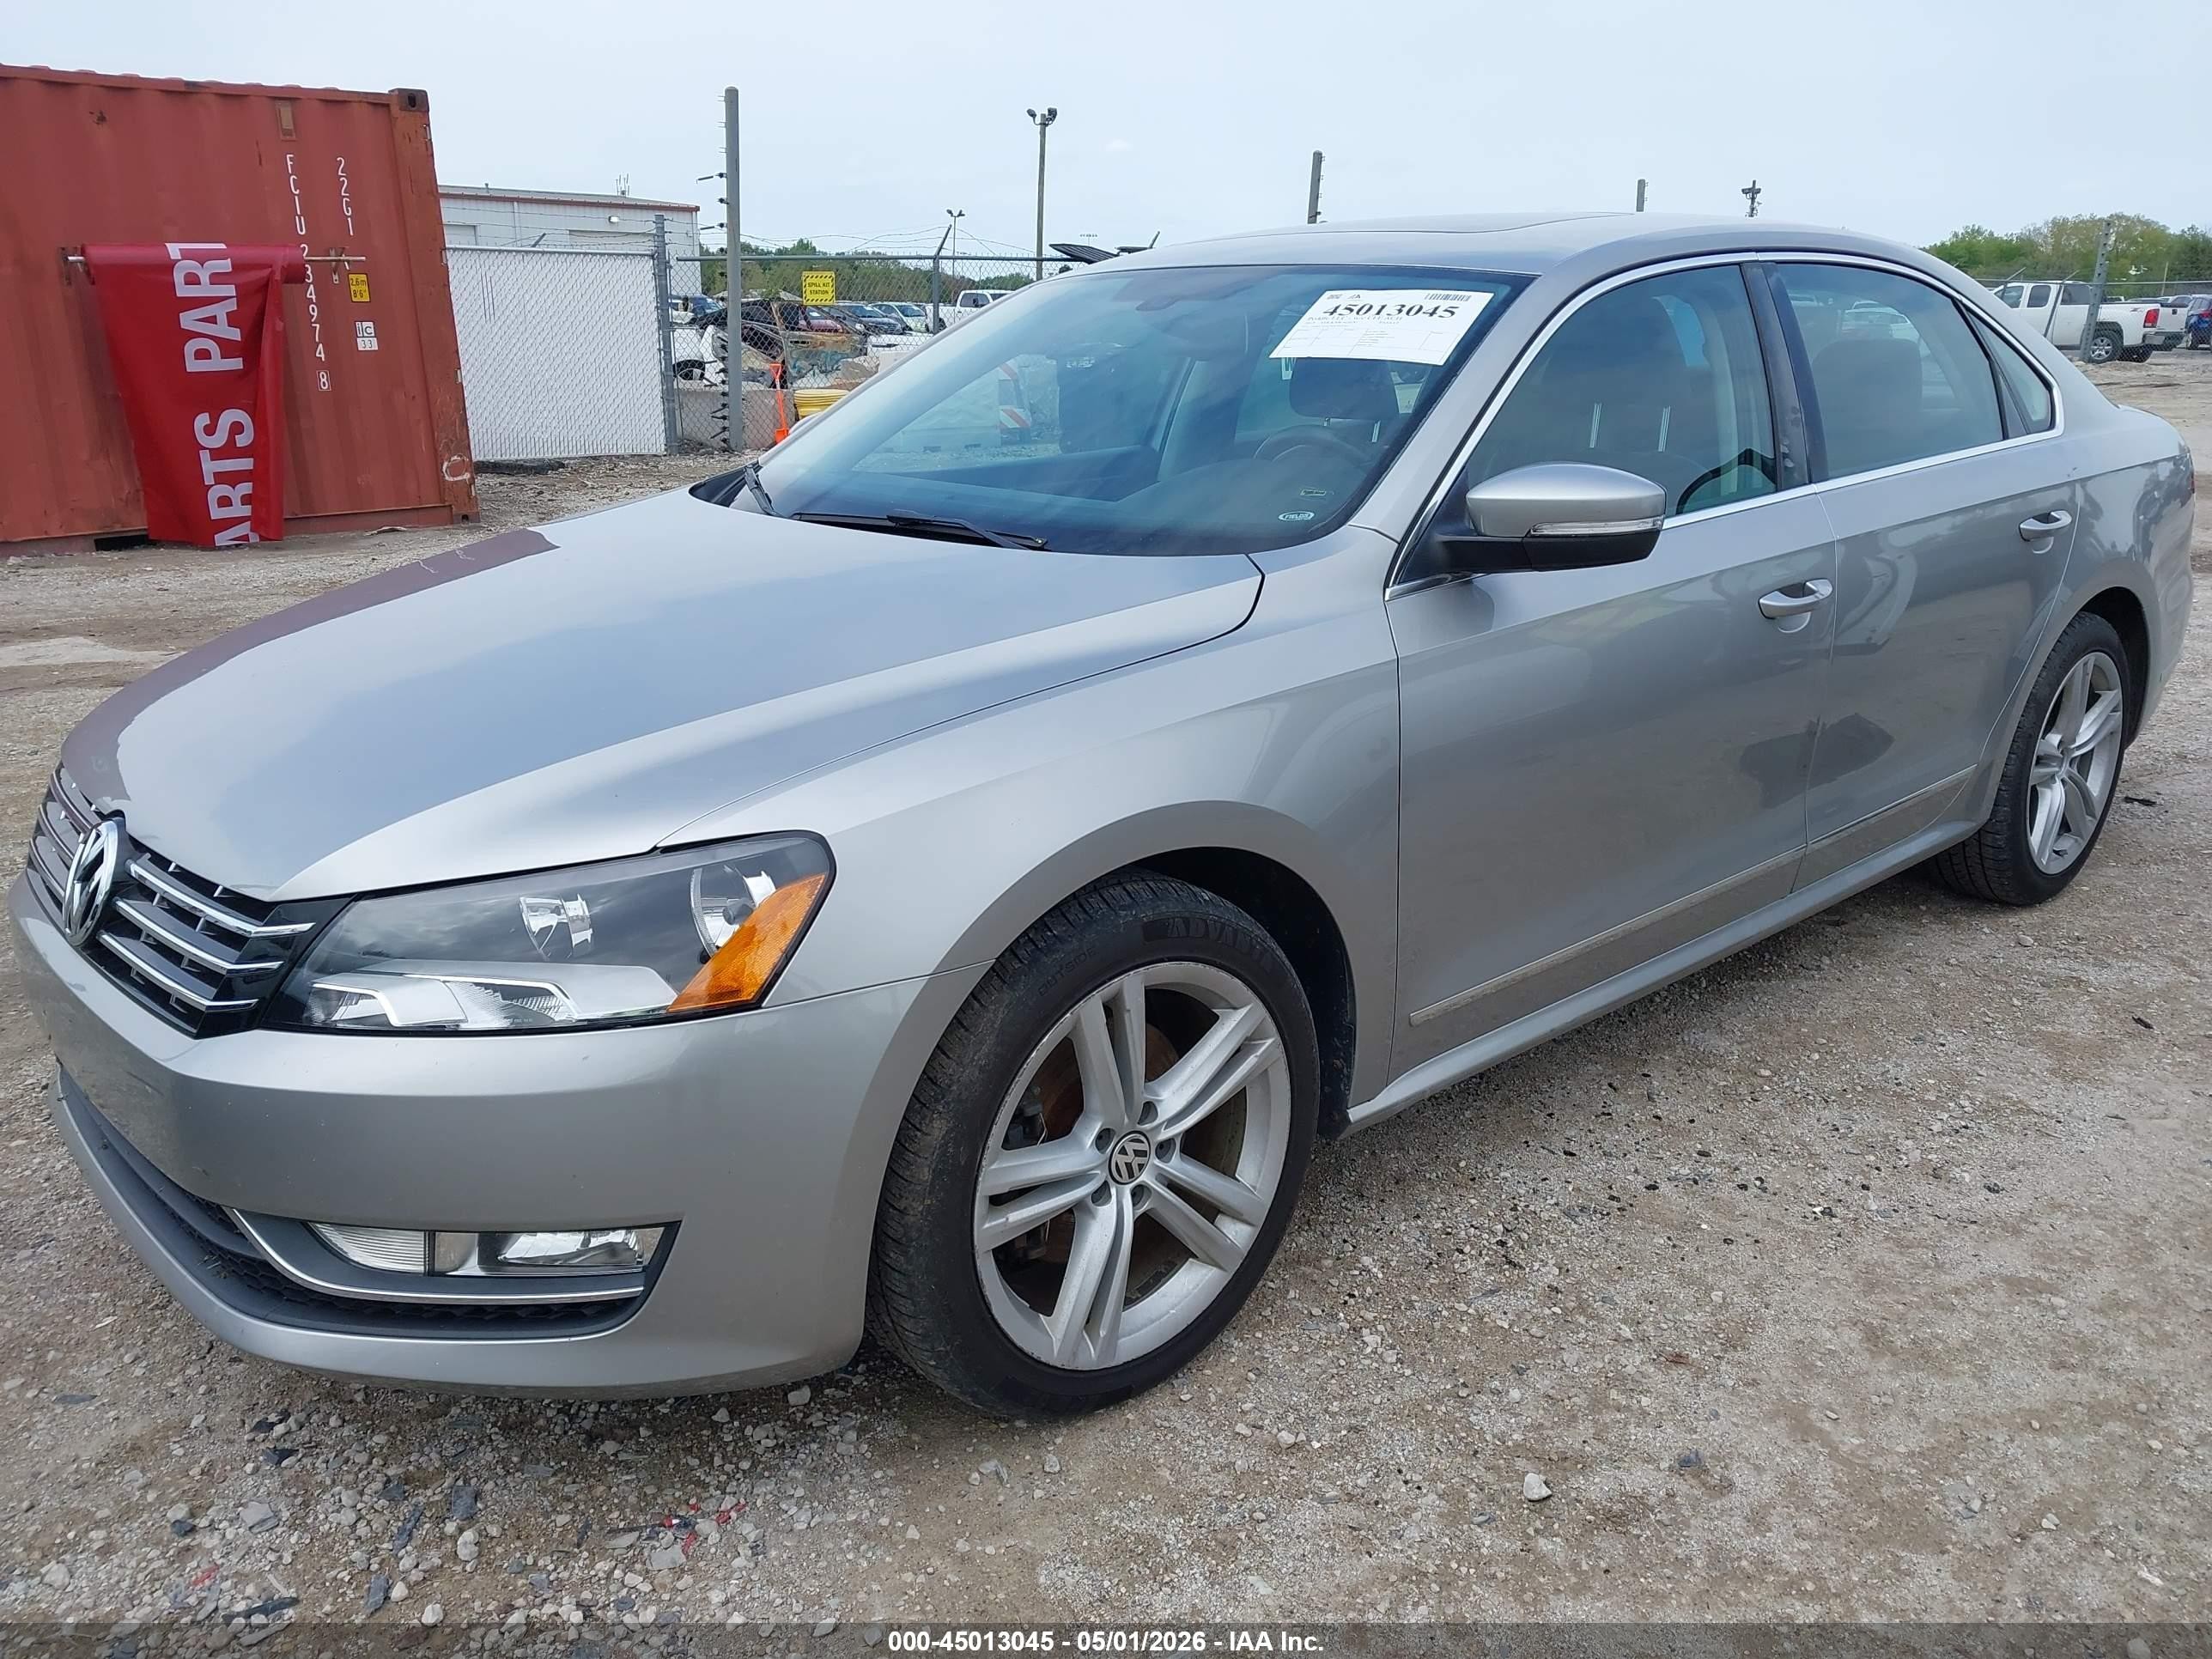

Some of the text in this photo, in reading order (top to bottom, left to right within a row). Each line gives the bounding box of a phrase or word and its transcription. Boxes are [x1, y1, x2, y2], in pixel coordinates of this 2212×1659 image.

[337, 157, 354, 236] 22G1
[287, 155, 306, 235] FCIU
[318, 371, 329, 390] 8
[1323, 304, 1460, 319] 45013045
[362, 339, 374, 349] 33
